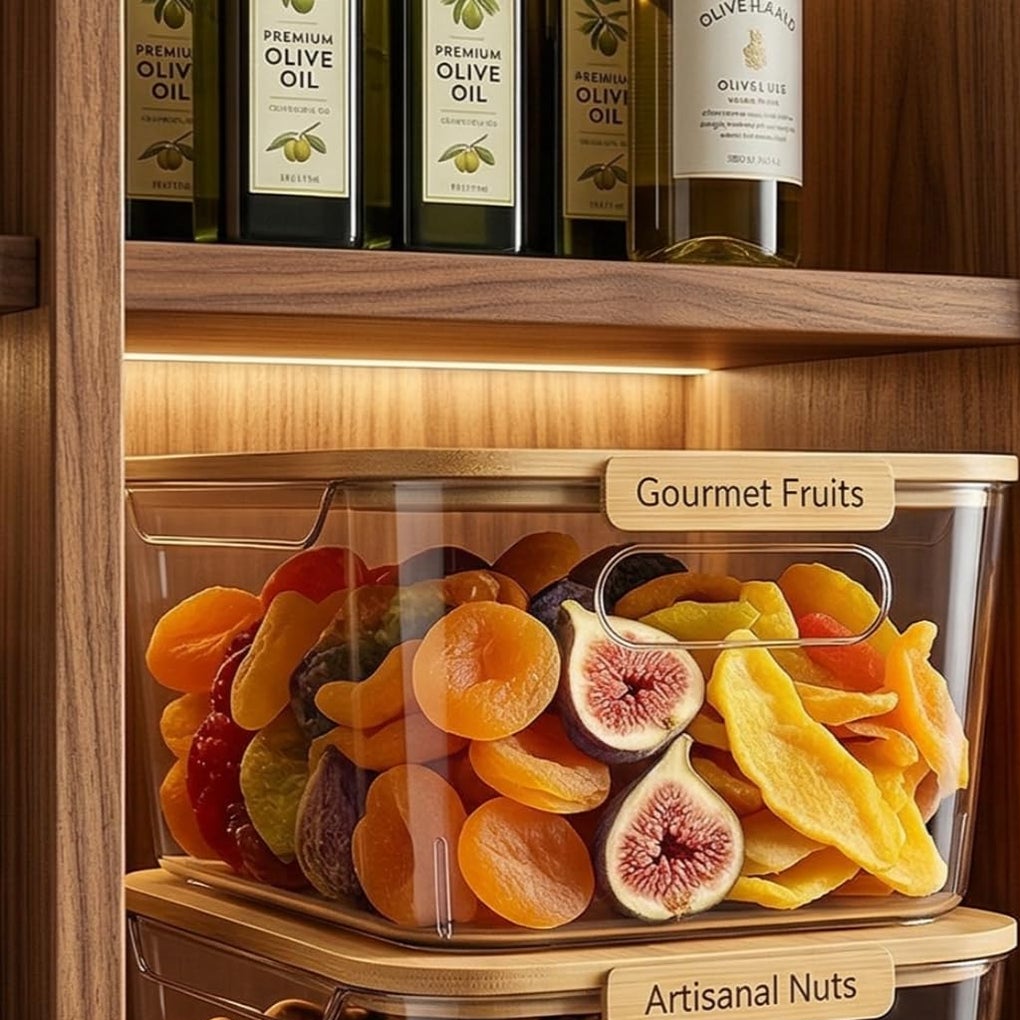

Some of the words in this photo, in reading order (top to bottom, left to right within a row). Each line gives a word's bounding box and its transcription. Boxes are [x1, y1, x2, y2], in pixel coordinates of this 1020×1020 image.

[263, 30, 334, 45] PREMIUM
[135, 44, 192, 58] PREMIU
[264, 47, 334, 68] OLIVE
[435, 45, 502, 60] PREMIUM
[136, 61, 192, 79] OLIV
[280, 70, 319, 89] OIL
[436, 62, 501, 83] OLIVE
[152, 82, 190, 101] OIL
[451, 84, 487, 103] OIL
[589, 107, 623, 125] OIL
[636, 476, 772, 508] Gourmet
[782, 477, 864, 508] Fruits
[644, 973, 779, 1016] Artisanal
[789, 972, 857, 1004] Nuts
